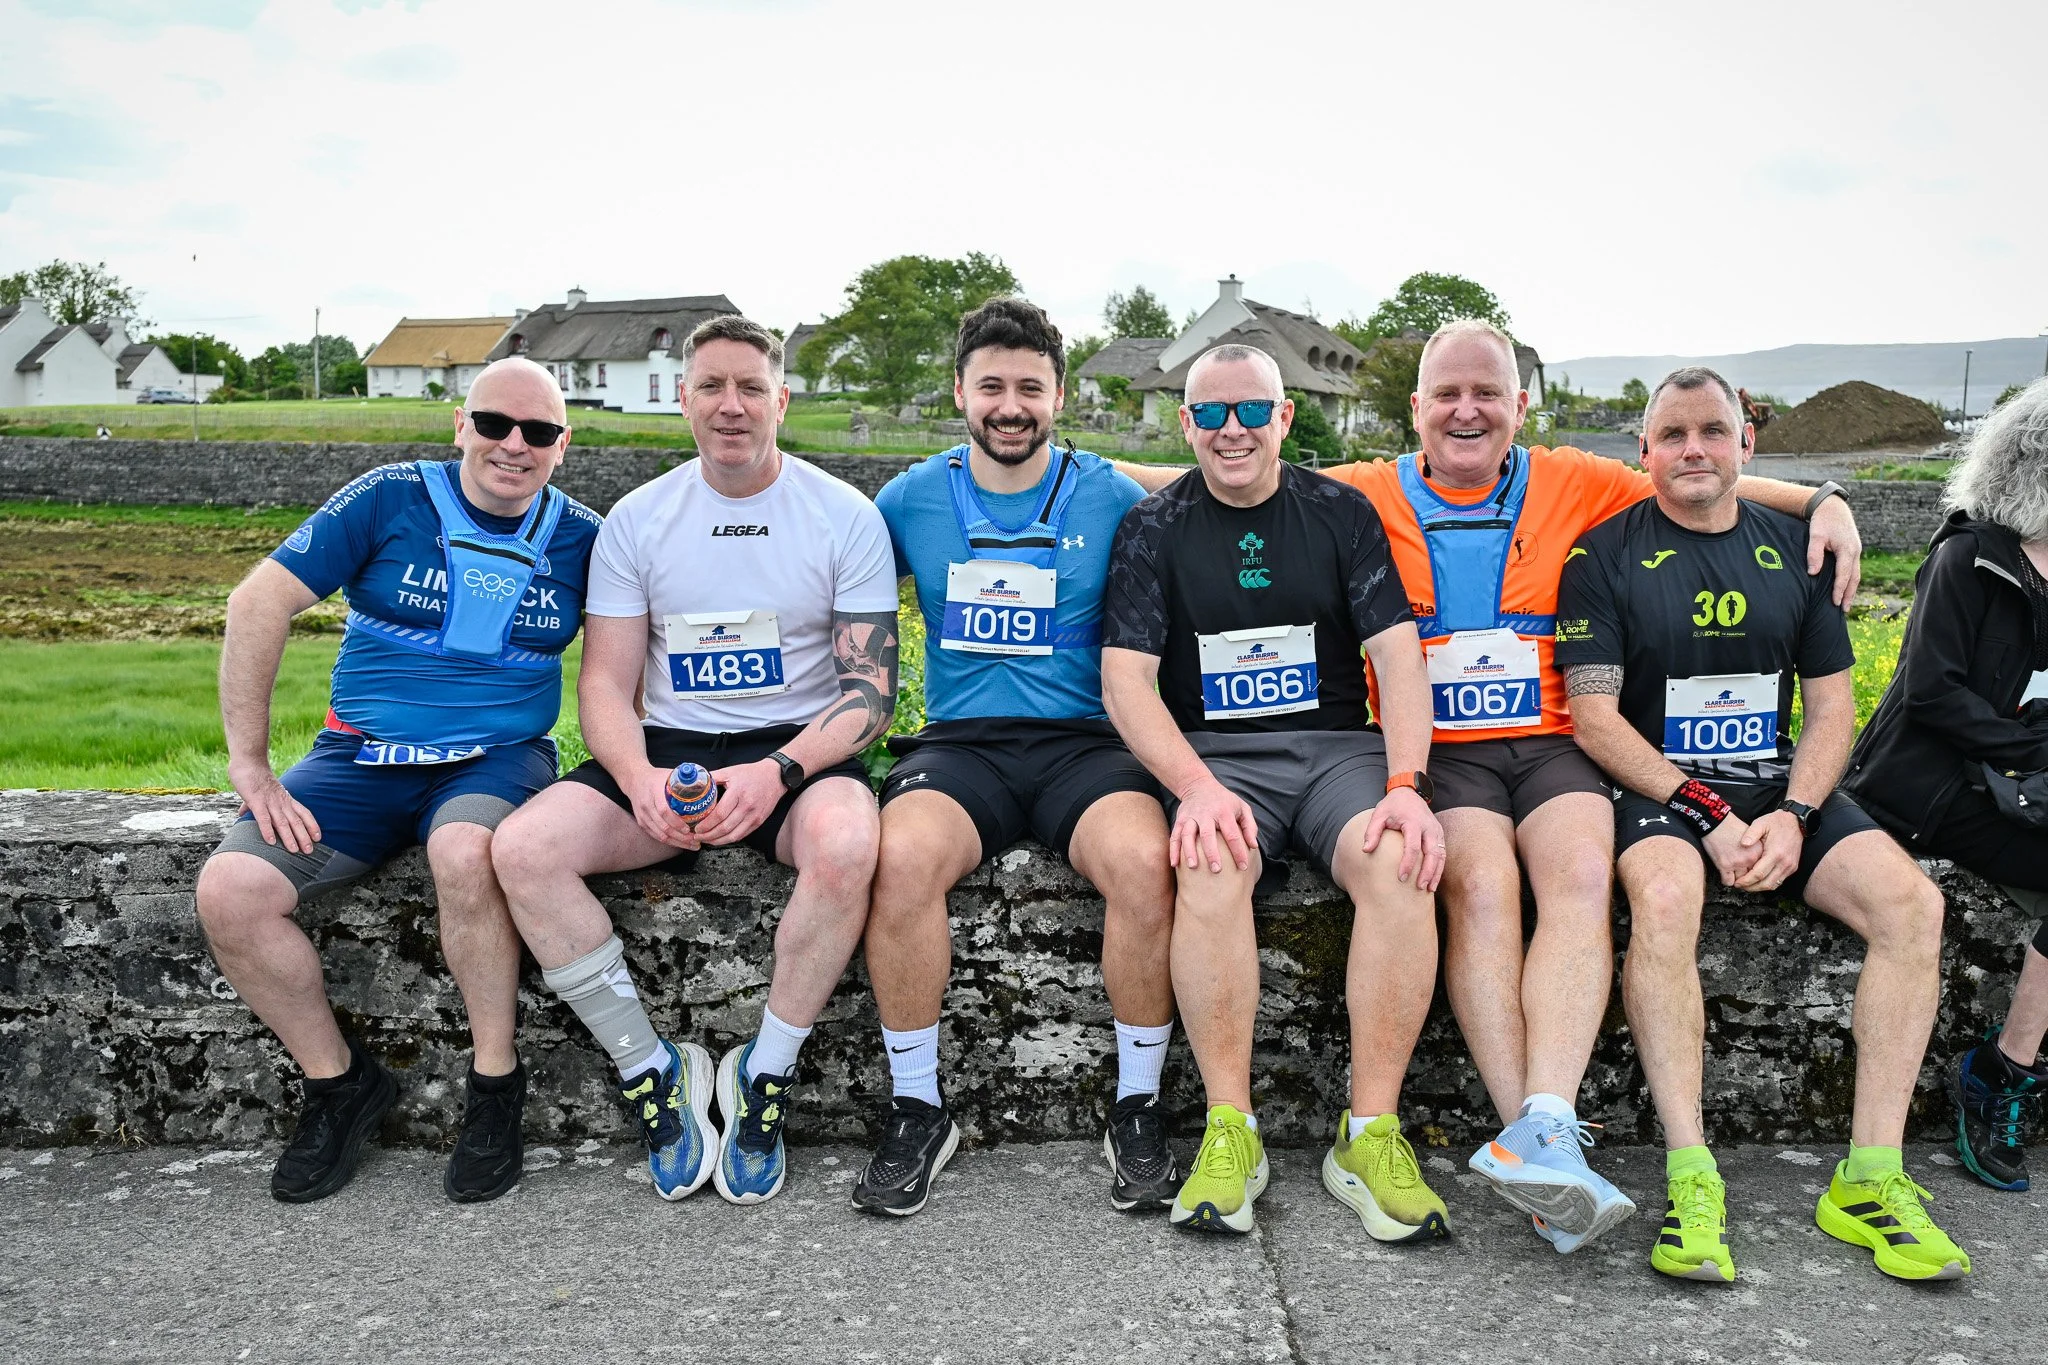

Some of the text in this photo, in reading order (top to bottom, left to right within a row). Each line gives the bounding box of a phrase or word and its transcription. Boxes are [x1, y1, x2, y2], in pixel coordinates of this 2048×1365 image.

[327, 472, 421, 517] TRIATHLON CLUB
[568, 507, 603, 528] TRIAT
[711, 525, 769, 537] LEGEA
[1242, 557, 1263, 565] IRFU
[463, 568, 516, 597] eos
[472, 589, 505, 602] ELITE
[397, 589, 561, 629] TRIAT CLUB
[961, 606, 1036, 641] 1019
[1410, 603, 1435, 614] Cla
[1692, 590, 1747, 627] 30
[681, 652, 766, 687] 1483
[1215, 668, 1304, 706] 1066
[1442, 682, 1526, 717] 1067
[1678, 716, 1763, 750] 1008
